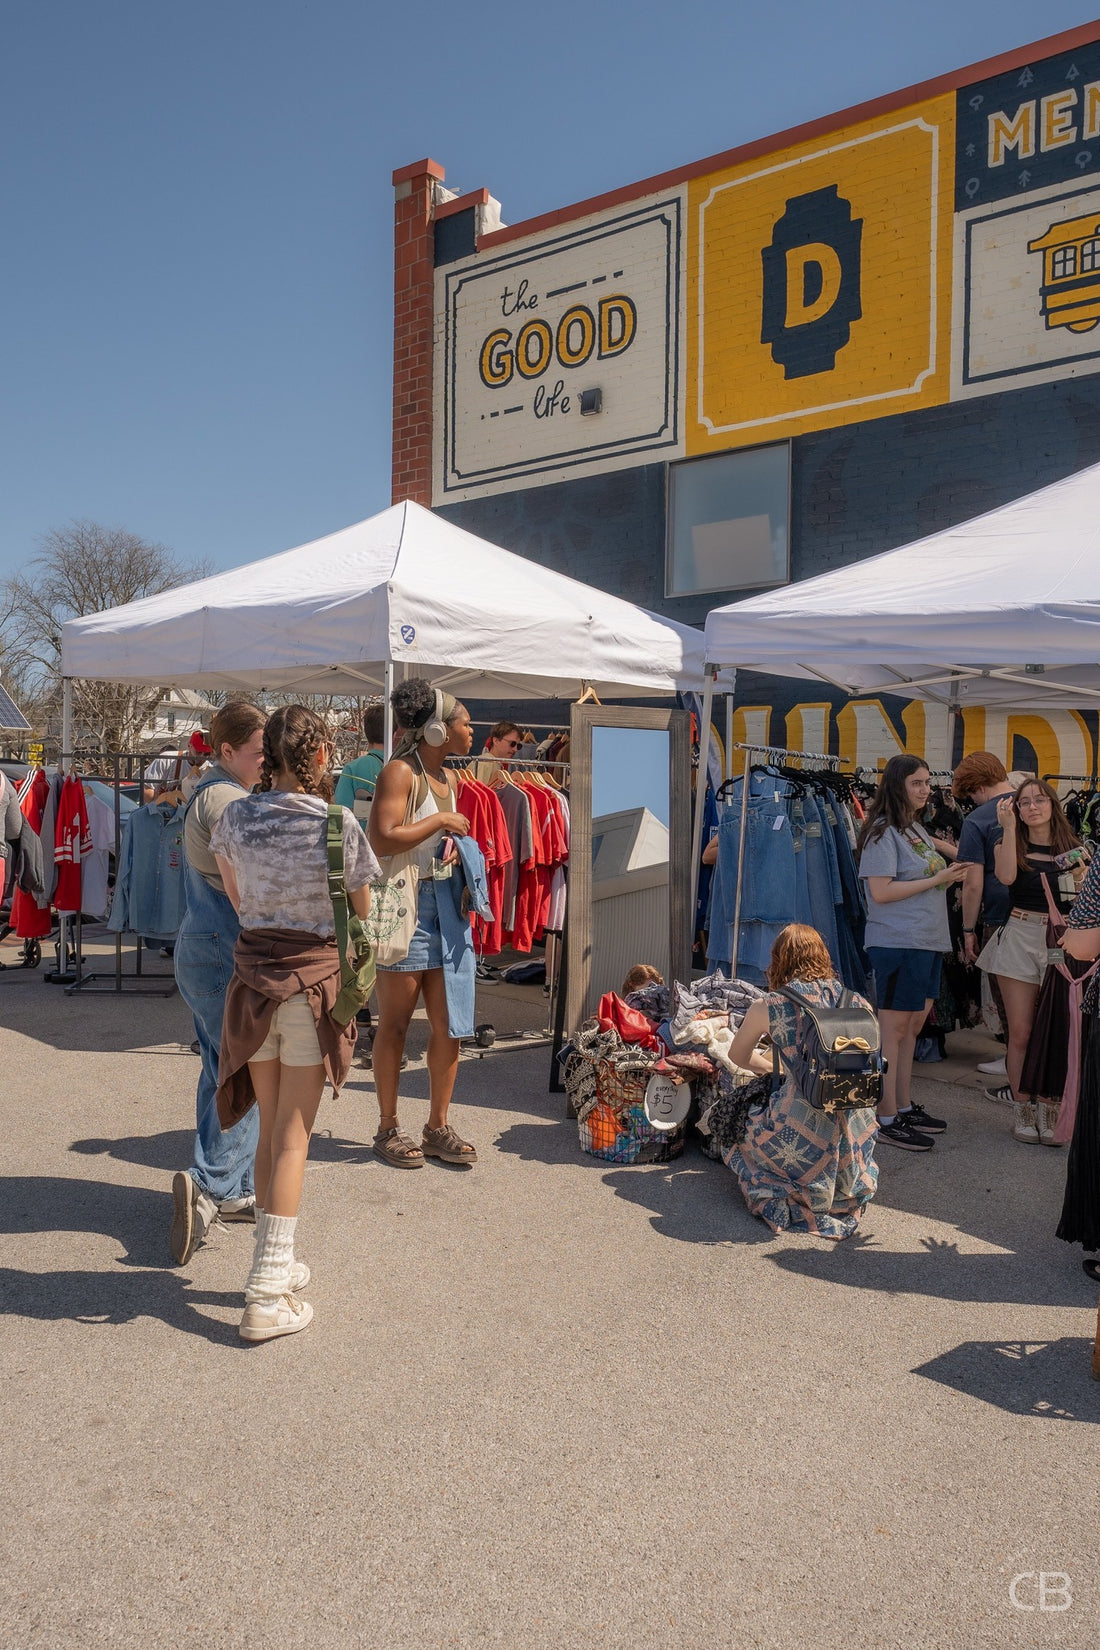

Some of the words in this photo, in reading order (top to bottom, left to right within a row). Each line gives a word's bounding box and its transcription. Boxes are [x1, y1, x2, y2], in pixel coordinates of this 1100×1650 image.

[500, 279, 538, 317] the
[784, 242, 842, 328] D
[479, 293, 637, 389] GOOD
[533, 380, 571, 419] life
[650, 1093, 673, 1115] $5
